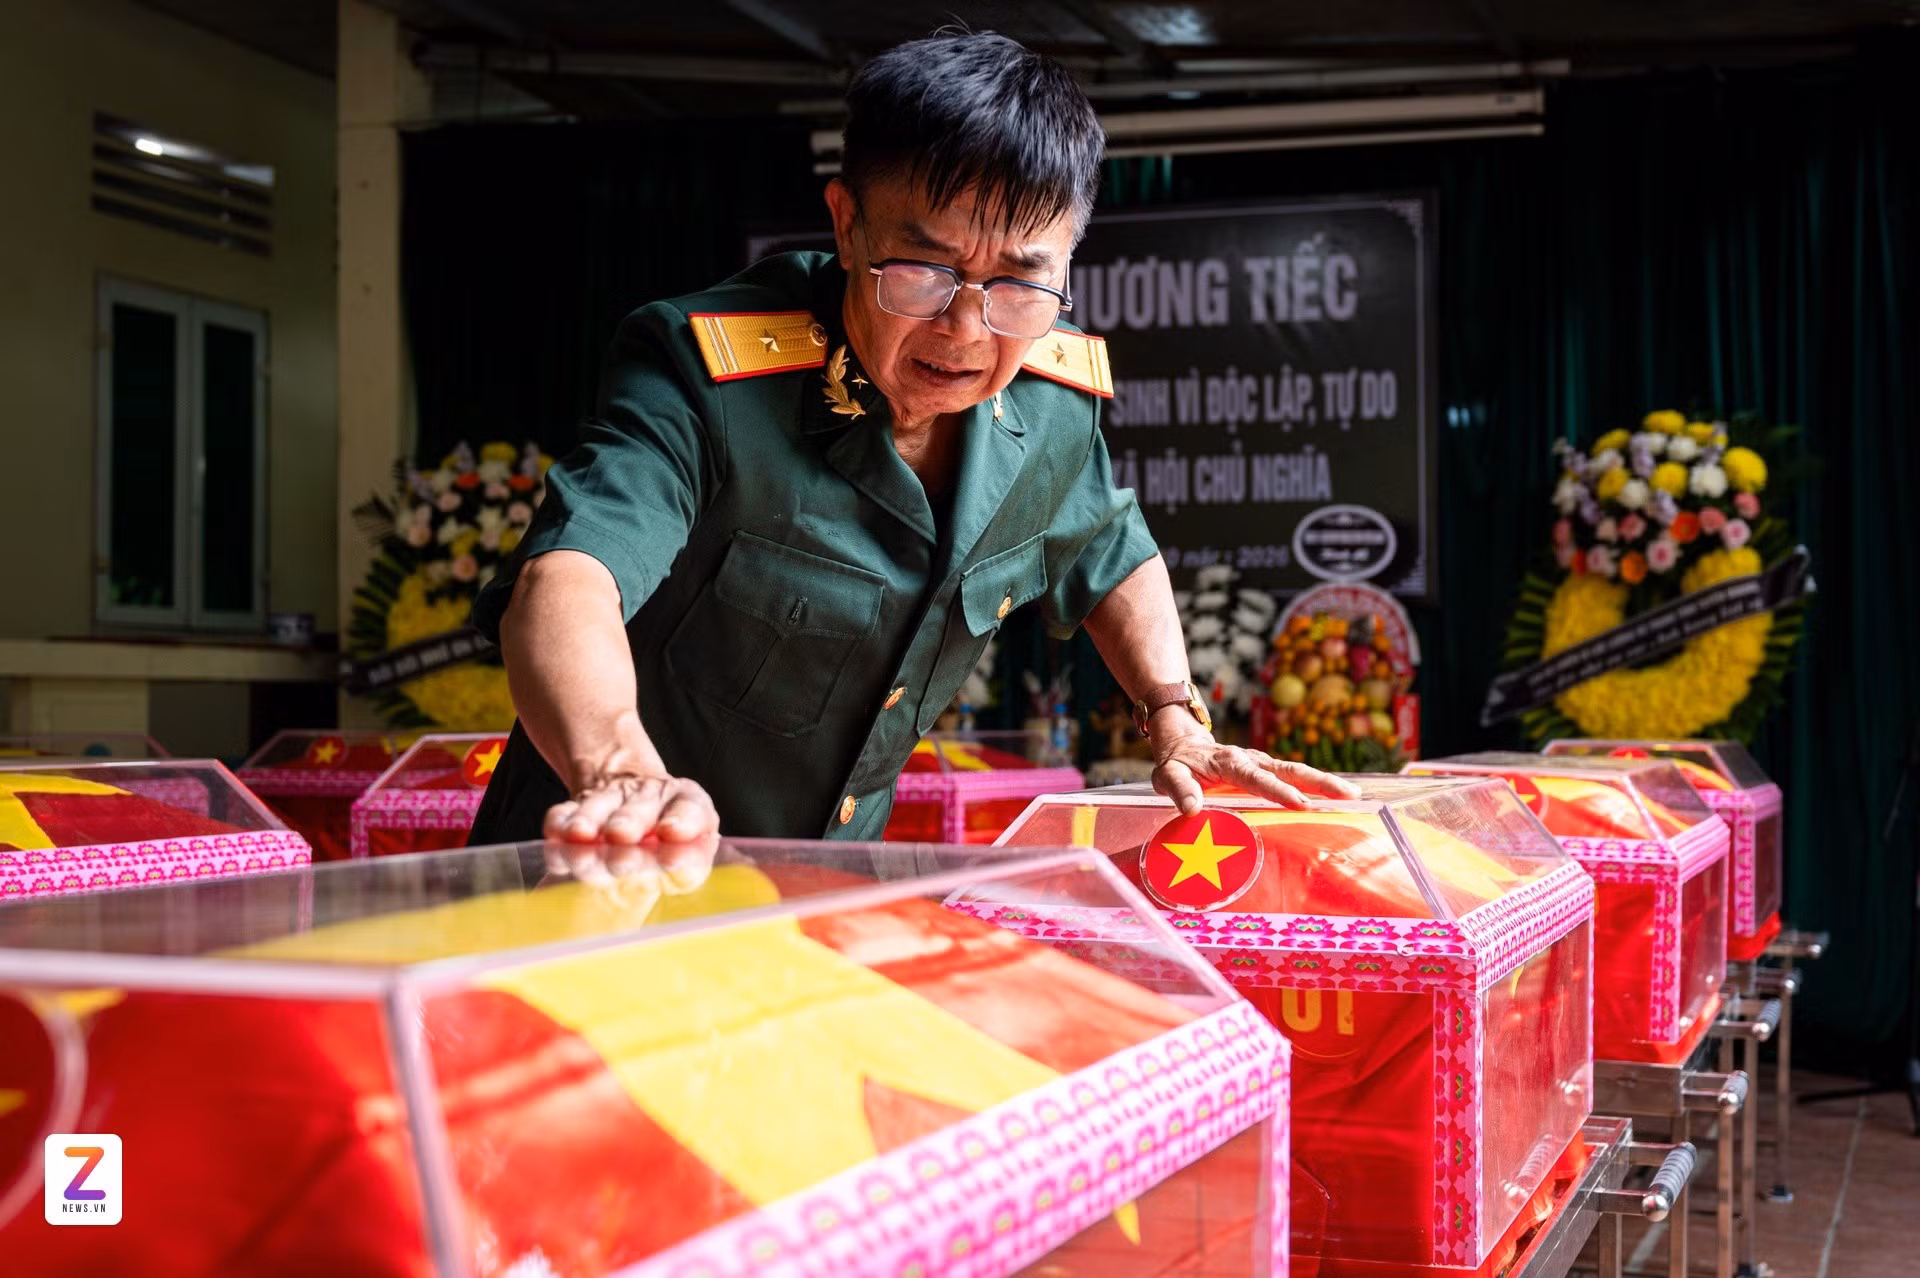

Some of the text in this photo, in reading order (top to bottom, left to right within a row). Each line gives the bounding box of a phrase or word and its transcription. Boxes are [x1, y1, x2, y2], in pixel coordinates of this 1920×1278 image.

[1243, 232, 1358, 325] TIẾC
[1109, 363, 1398, 433] SINH VÌ ĐỘC LẬP, TỰ DO
[1144, 447, 1189, 514] HỘI
[1193, 440, 1247, 504] CHỦ
[1251, 444, 1333, 502] NGHĨA
